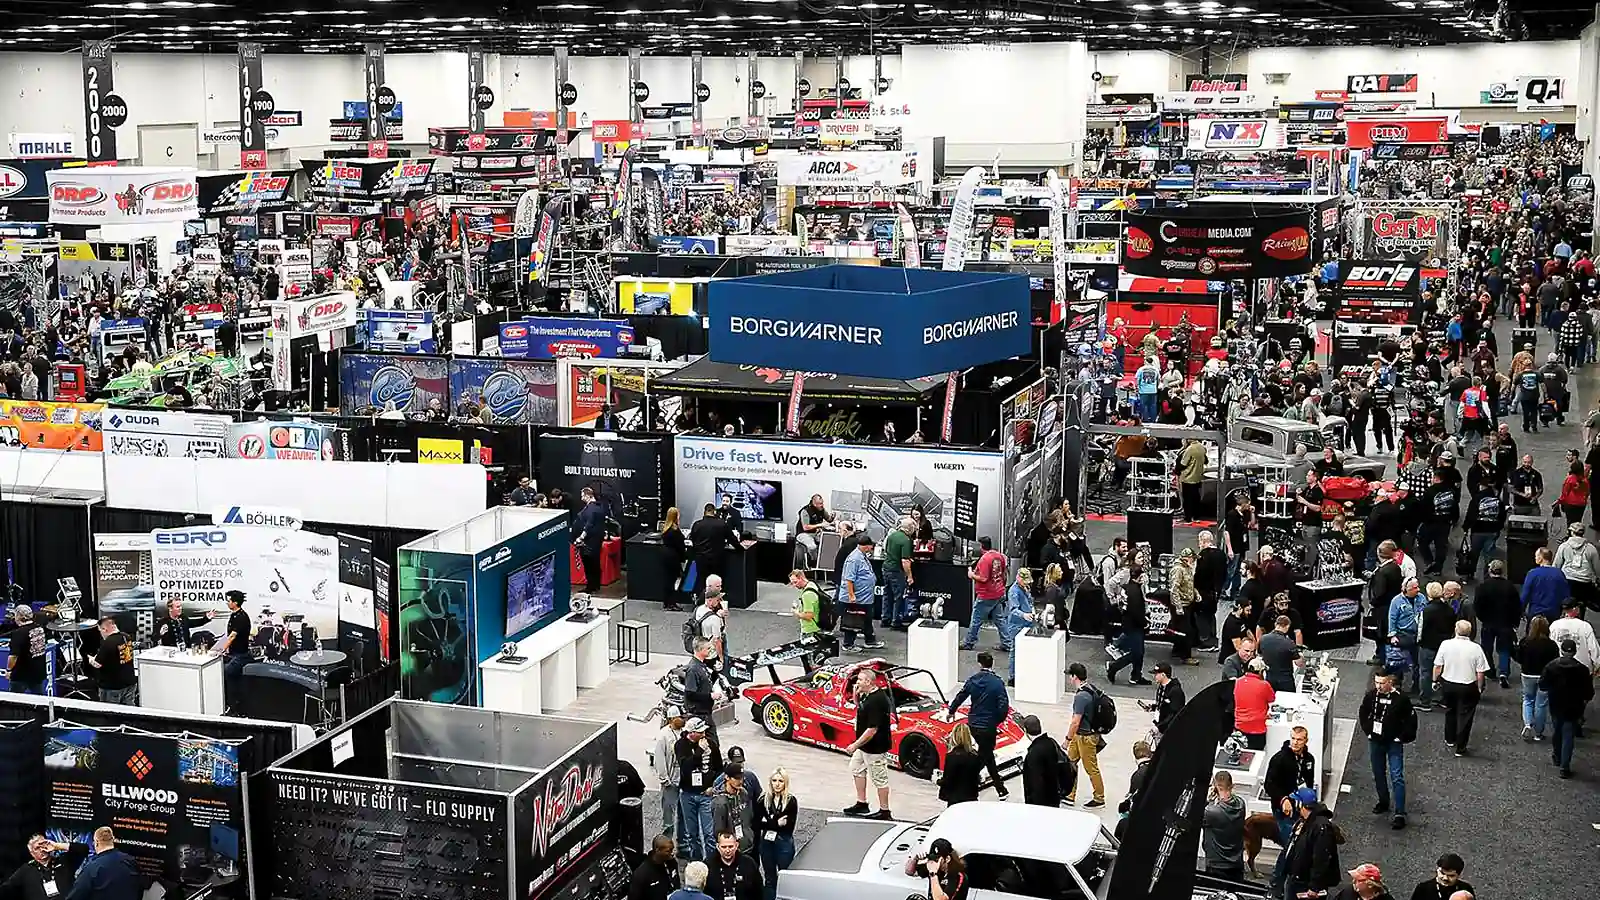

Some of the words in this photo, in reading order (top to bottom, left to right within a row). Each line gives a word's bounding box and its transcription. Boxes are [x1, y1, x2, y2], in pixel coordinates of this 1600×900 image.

[1350, 75, 1389, 93] QA1
[102, 105, 126, 118] 2000
[253, 100, 273, 111] 1900
[826, 124, 859, 135] DRIVEN
[1210, 123, 1264, 140] NX
[19, 141, 72, 154] MAHLE
[166, 146, 173, 157] C
[335, 167, 362, 180] TECH
[403, 164, 430, 177] TECH
[808, 161, 842, 174] ARCA
[253, 176, 289, 192] TECH
[54, 186, 97, 202] DRP
[77, 208, 106, 219] Products
[314, 302, 343, 317] DRP
[730, 316, 883, 345] BORGWARNER
[923, 310, 1019, 345] BORGWARNER
[276, 449, 318, 461] WEAVING
[682, 446, 725, 463] Drive
[730, 447, 767, 465] fast.
[772, 450, 824, 470] Worry
[829, 453, 868, 471] less.
[710, 464, 737, 473] insurance
[738, 465, 746, 473] for
[747, 467, 767, 477] people
[934, 463, 966, 472] HAGERTY
[156, 532, 227, 547] EDRO
[158, 556, 204, 567] PREMIUM
[205, 557, 238, 567] ALLOYS
[158, 569, 179, 579] AND
[180, 569, 222, 580] SERVICES
[224, 569, 243, 580] FOR
[159, 579, 224, 591] OPTIMIZED
[918, 590, 952, 600] Insurance
[102, 783, 179, 805] ELLWOOD
[105, 798, 122, 810] City
[123, 800, 149, 813] Forge
[150, 803, 176, 817] Group
[278, 783, 306, 801] NEED
[310, 786, 328, 803] IT?
[332, 788, 368, 807] WE'VE
[371, 793, 393, 810] GOT
[397, 796, 408, 812] IT
[426, 799, 446, 817] FLO
[451, 802, 496, 822] SUPPLY
